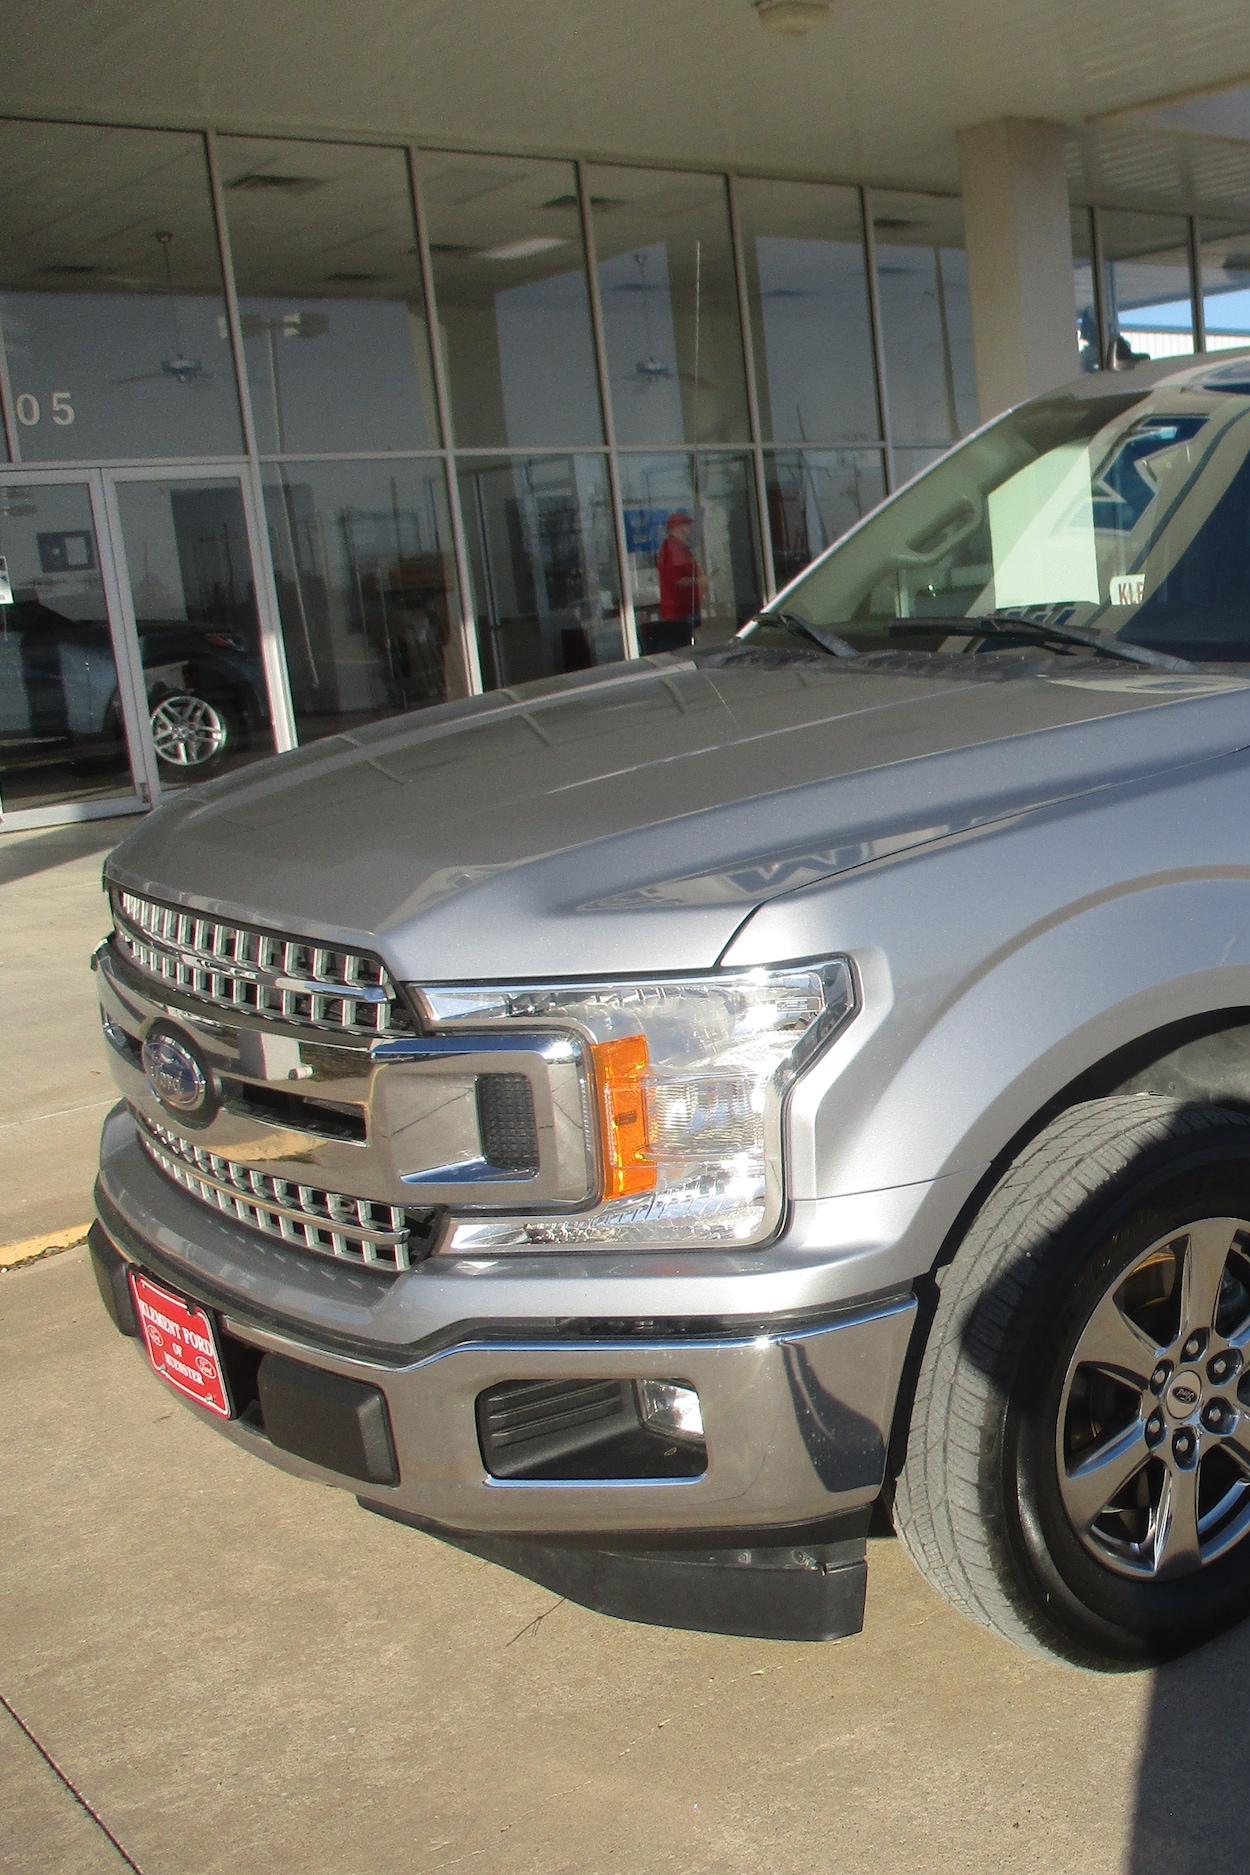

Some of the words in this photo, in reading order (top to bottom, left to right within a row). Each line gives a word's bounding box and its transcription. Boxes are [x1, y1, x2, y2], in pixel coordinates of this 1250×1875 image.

[138, 1299, 182, 1341] KLEMENT
[182, 1326, 214, 1357] FORD
[163, 1350, 205, 1386] MUENSTER
[171, 1342, 183, 1358] OF
